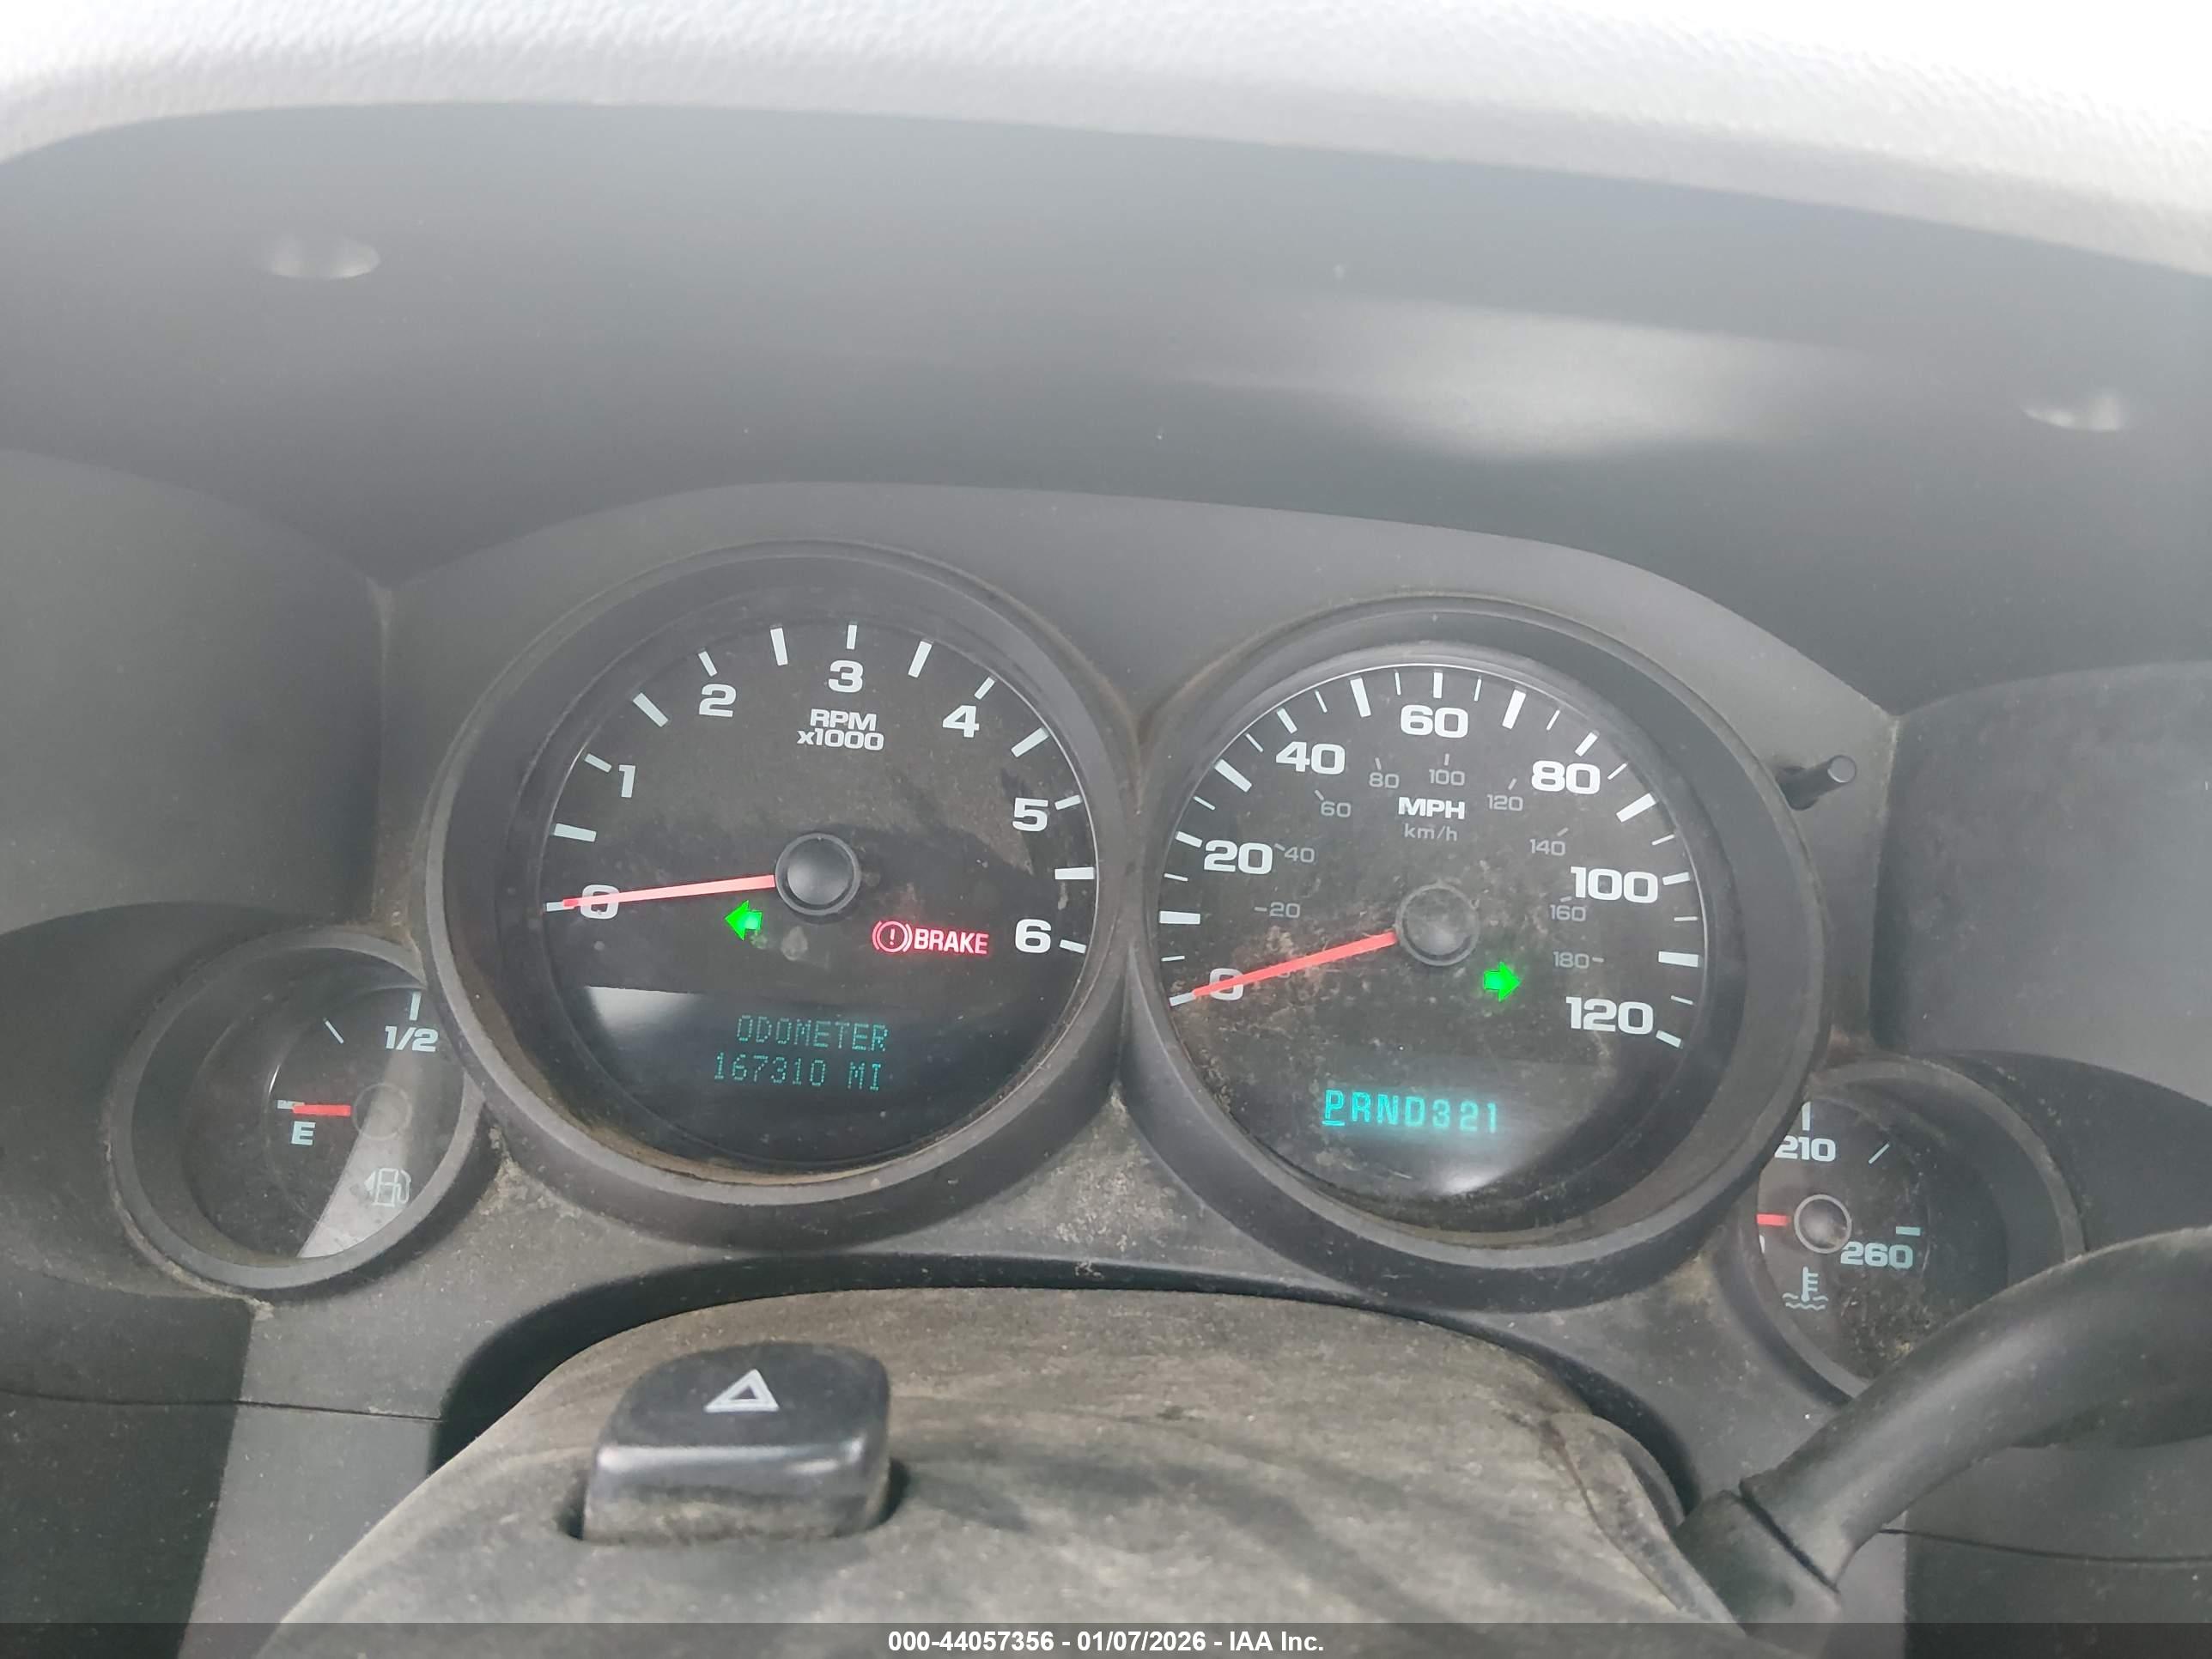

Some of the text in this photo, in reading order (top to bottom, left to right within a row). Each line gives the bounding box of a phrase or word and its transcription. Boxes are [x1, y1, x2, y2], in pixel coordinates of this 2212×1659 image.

[828, 659, 864, 694] 3
[698, 684, 737, 718] 2
[809, 708, 877, 731] RPM
[942, 705, 980, 738] 4
[1399, 704, 1469, 738] 60
[797, 727, 884, 751] x1000
[1275, 741, 1346, 775] 40
[617, 764, 636, 798] 1
[1369, 771, 1400, 789] 80
[1428, 769, 1466, 787] 100
[1531, 760, 1601, 794] 80
[1012, 798, 1049, 832] 5
[1320, 800, 1352, 818] 60
[1398, 795, 1466, 819] MPH
[1486, 793, 1523, 812] 120
[1404, 823, 1458, 842] km/h
[1529, 837, 1566, 856] 140
[1203, 841, 1273, 875] 20
[1284, 846, 1316, 863] 40
[1571, 866, 1658, 904] 100
[580, 884, 619, 920] 0
[1269, 902, 1301, 919] 20
[1549, 903, 1586, 922] 160
[913, 927, 989, 956] BRAKE
[1014, 919, 1052, 954] 6
[1553, 951, 1590, 969] 180
[1565, 996, 1654, 1036] 120
[385, 1025, 439, 1053] 1/2
[736, 1014, 890, 1053] ODOMETER
[714, 1052, 882, 1091] 167310 MI
[290, 1121, 316, 1146] E
[1774, 1134, 1836, 1162] 210
[1840, 1241, 1913, 1269] 260
